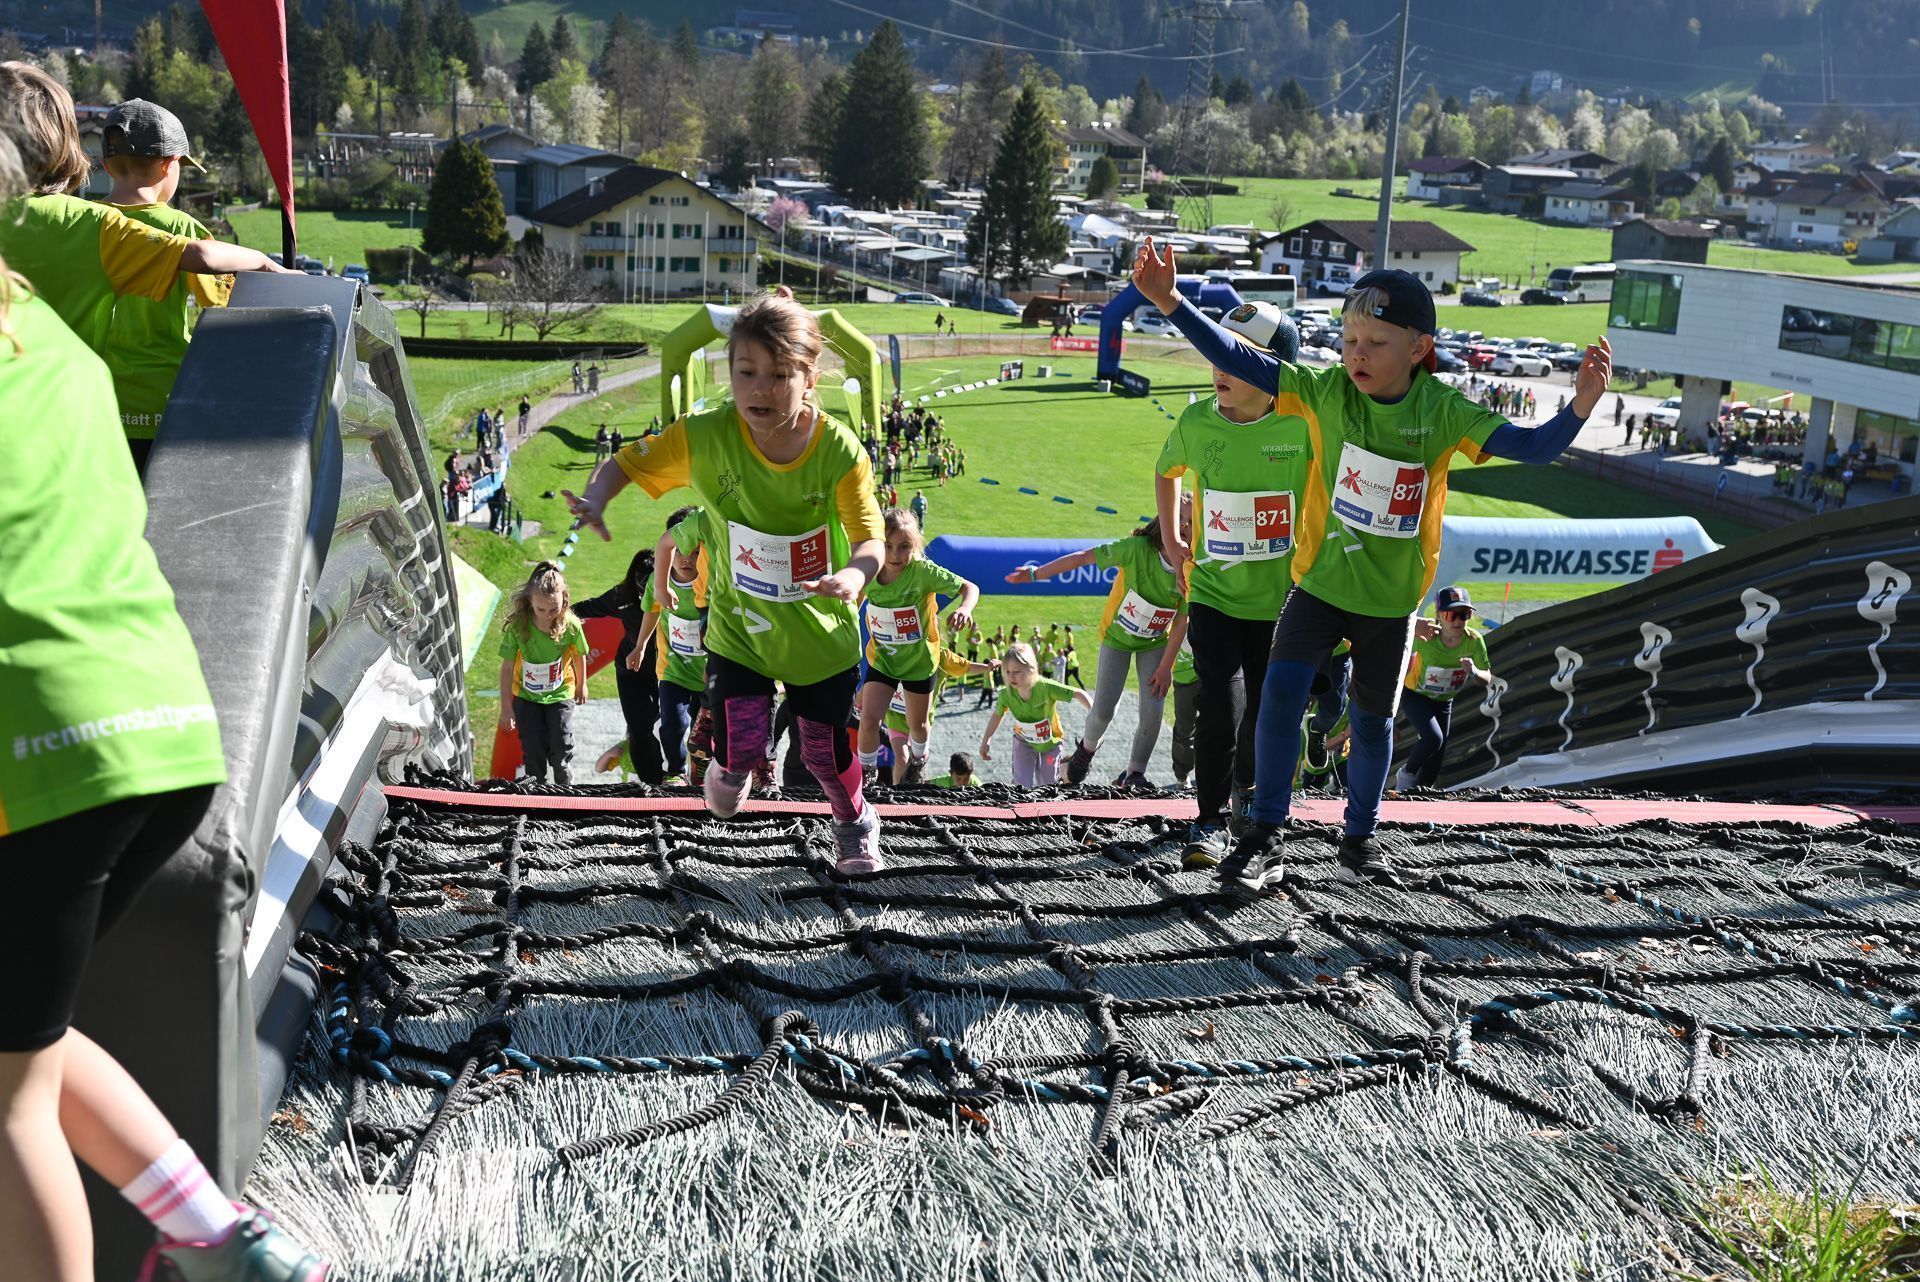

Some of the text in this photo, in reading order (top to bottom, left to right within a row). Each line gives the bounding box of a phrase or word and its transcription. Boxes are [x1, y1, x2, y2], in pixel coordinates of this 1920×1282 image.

[1355, 477, 1392, 493] CHALLENGE
[1393, 482, 1423, 501] 877
[1220, 515, 1254, 523] CHALLENGE
[1256, 509, 1290, 527] 871
[801, 539, 819, 555] 51
[750, 553, 790, 566] CHALLENGE
[803, 555, 817, 564] Lisa
[1471, 547, 1650, 575] SPARKASSE
[1871, 576, 1898, 610] 6
[896, 616, 917, 627] 859
[1151, 616, 1171, 625] 867
[1745, 601, 1771, 630] 7
